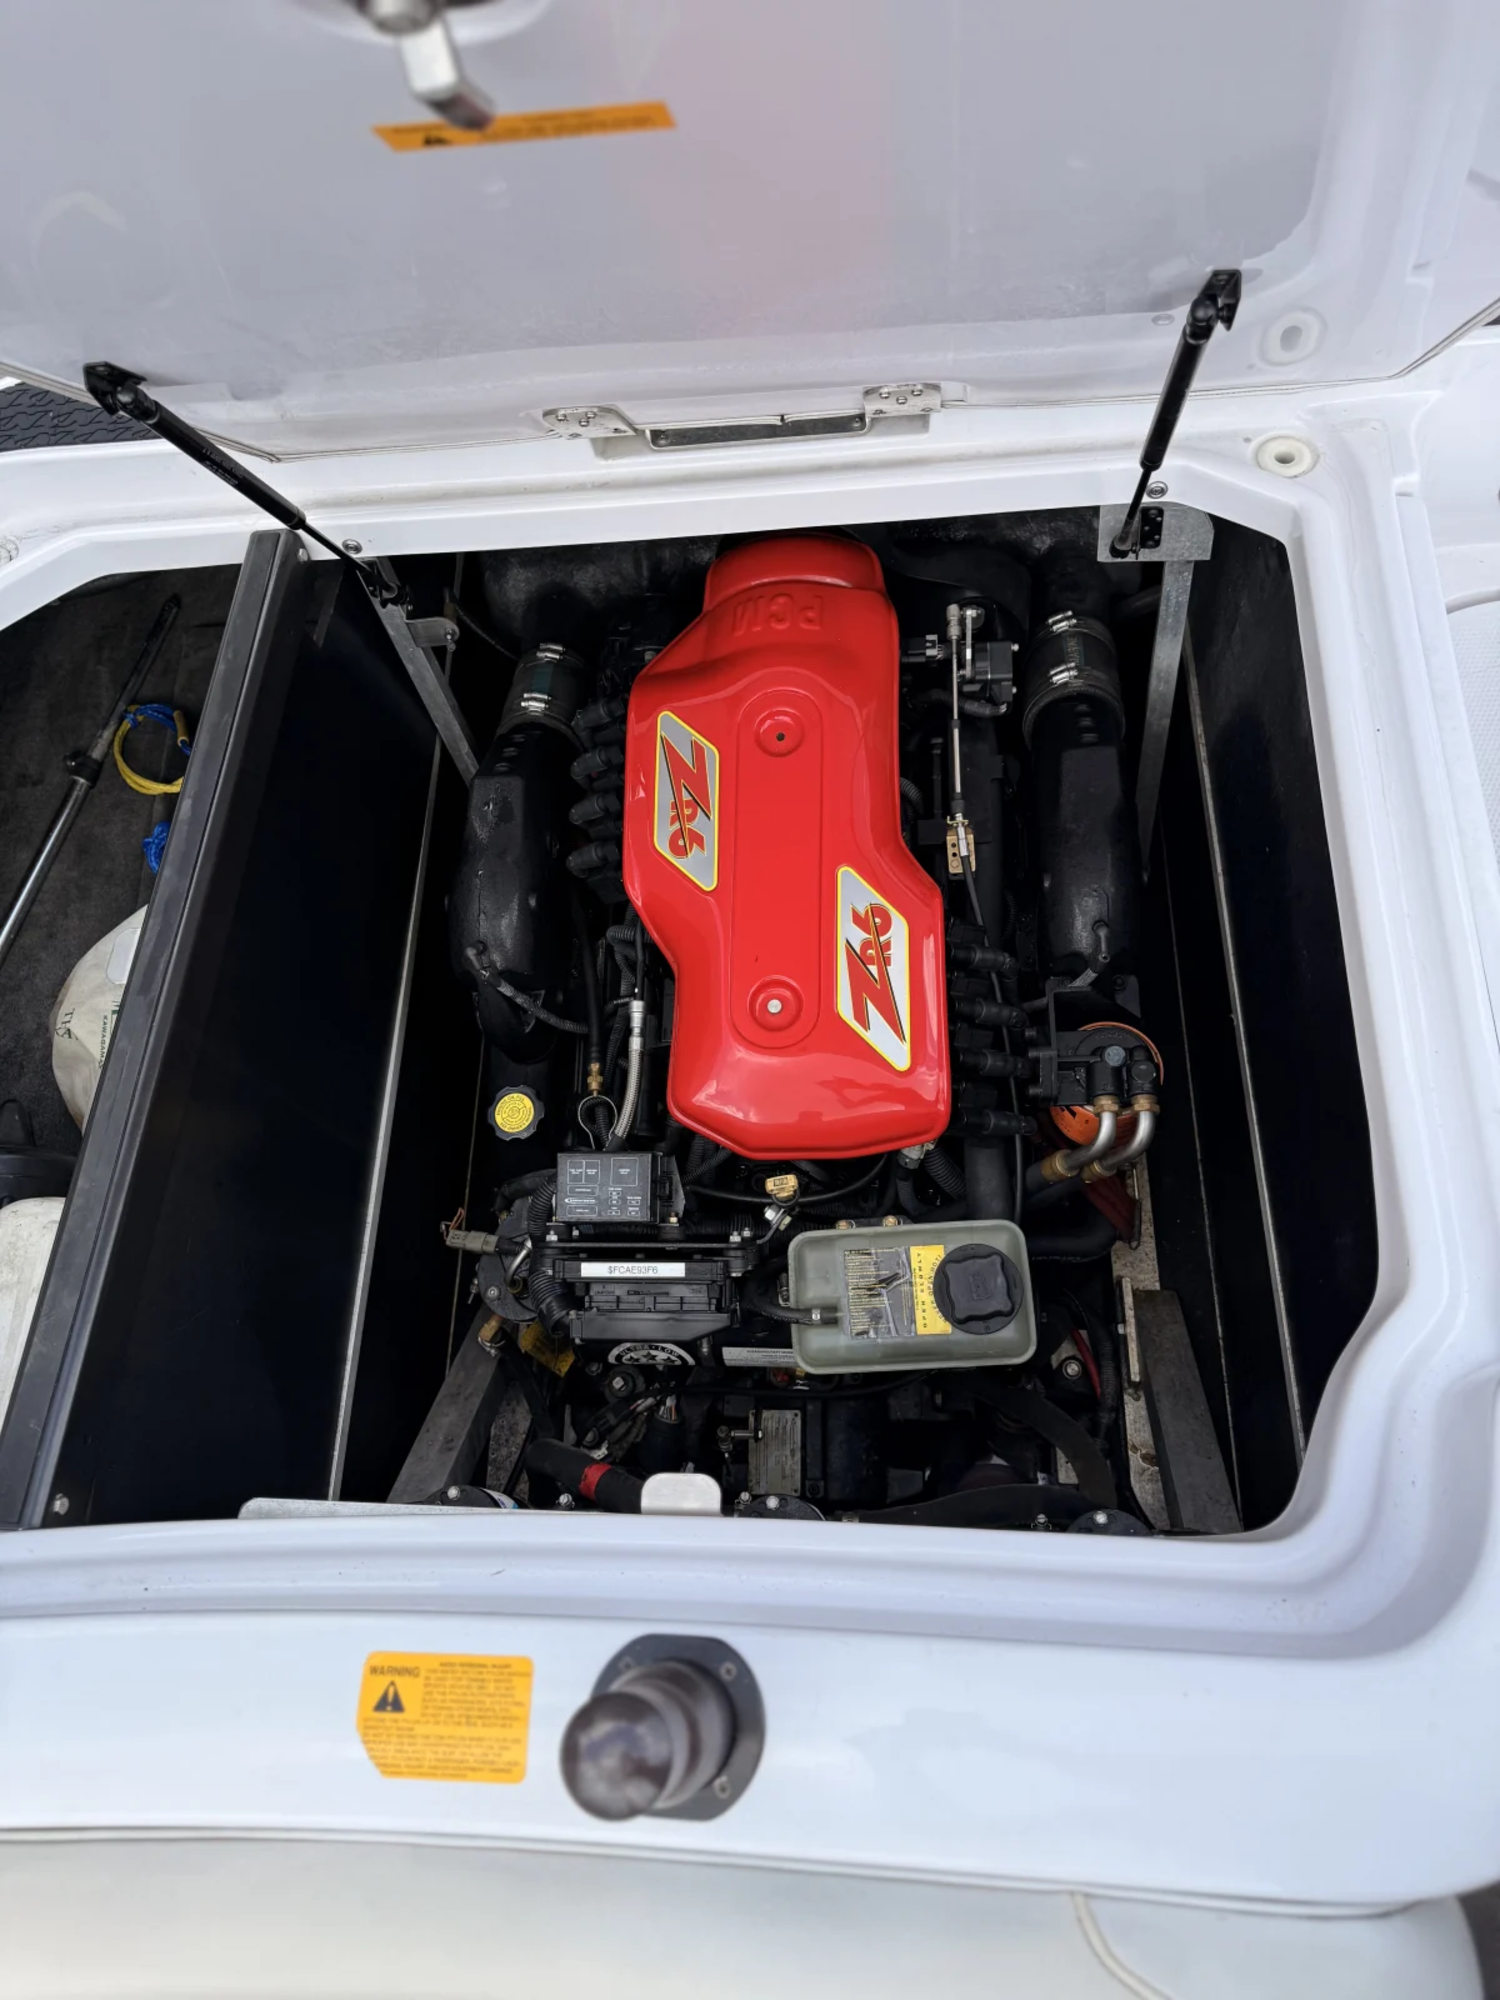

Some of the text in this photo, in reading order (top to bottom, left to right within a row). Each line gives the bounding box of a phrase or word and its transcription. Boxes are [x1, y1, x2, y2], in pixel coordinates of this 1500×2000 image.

[732, 592, 824, 636] PCM
[660, 730, 713, 860] ZR6
[844, 902, 907, 1048] ZR6
[607, 1265, 659, 1275] $FCAE93F6
[917, 1252, 928, 1329] OPEN SLOWLY
[620, 1344, 680, 1356] ULTRA LOW
[369, 1664, 420, 1678] WARNING
